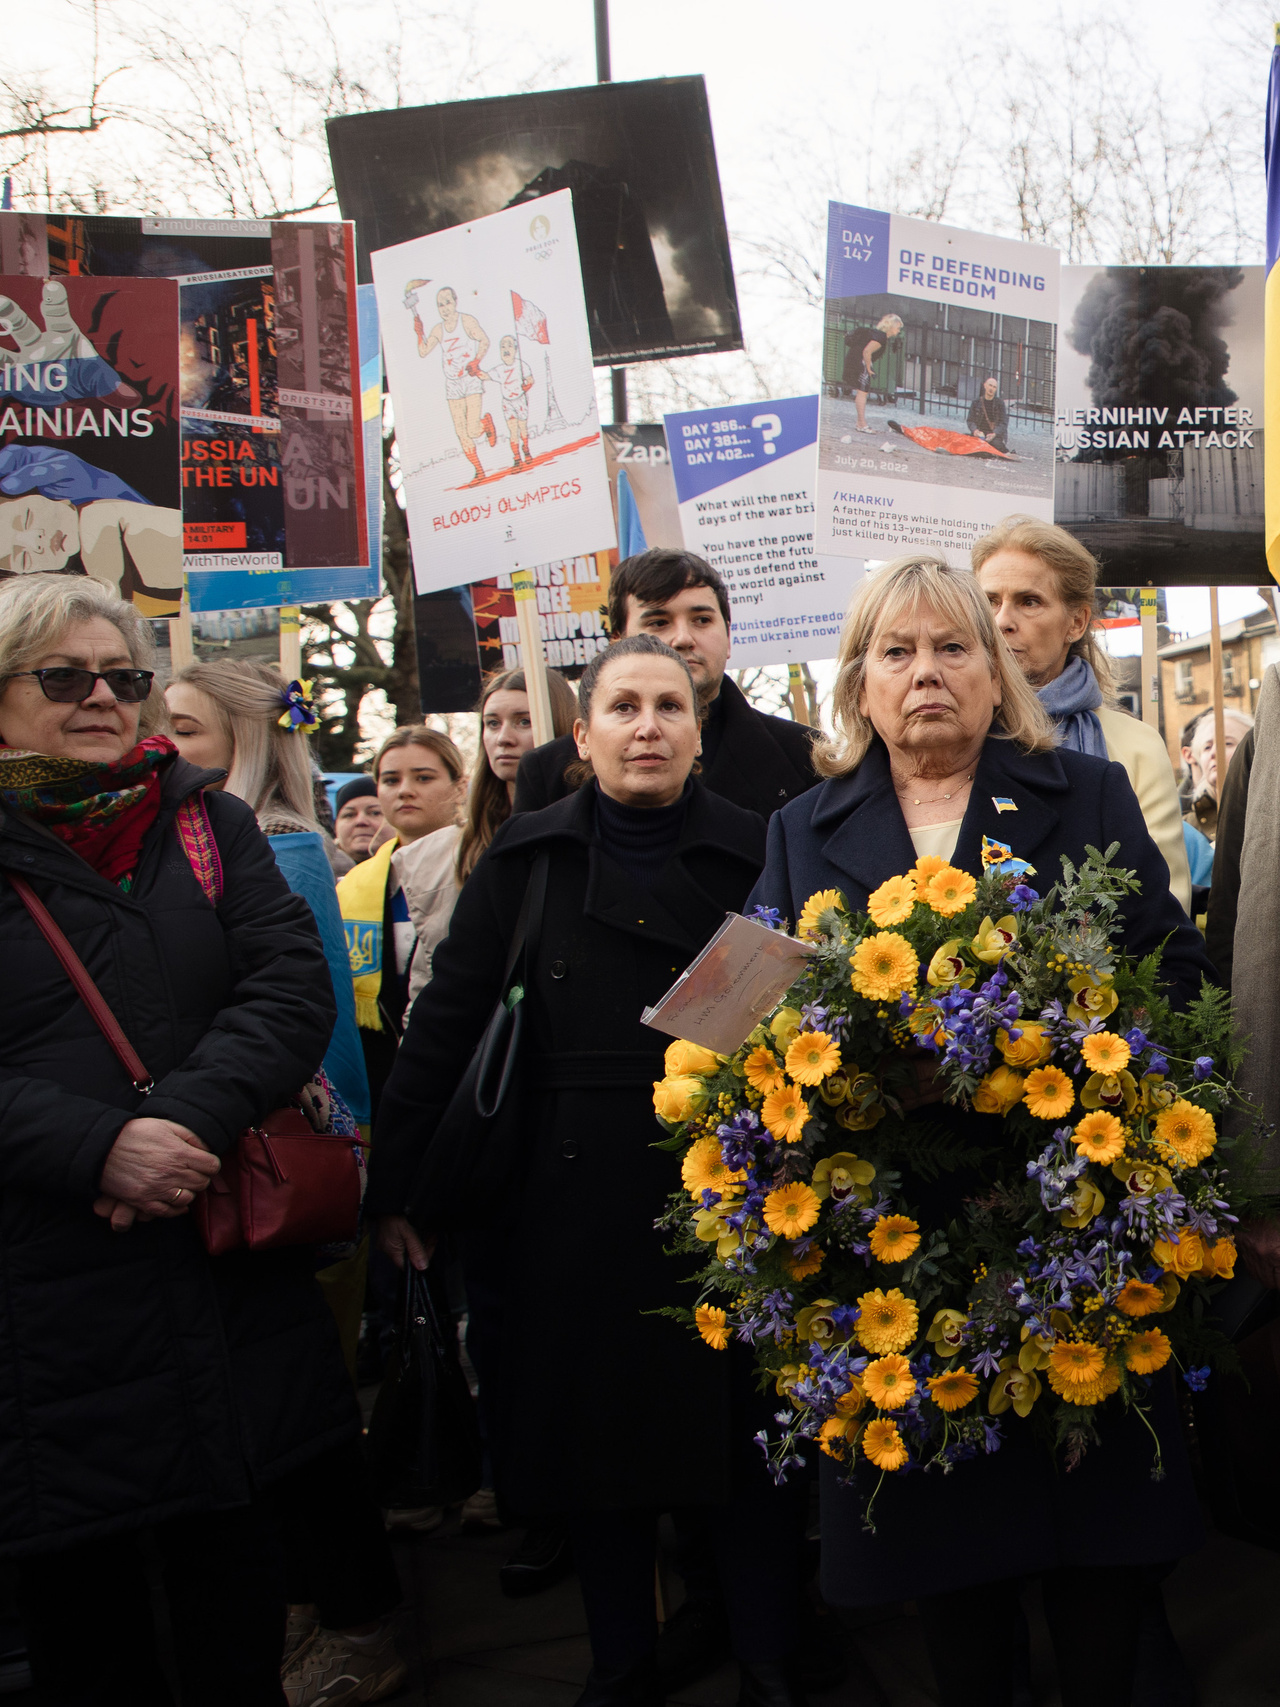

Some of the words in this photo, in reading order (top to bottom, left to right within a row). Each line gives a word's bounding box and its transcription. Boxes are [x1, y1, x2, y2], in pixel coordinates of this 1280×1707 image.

[842, 230, 875, 247] DAY
[843, 247, 873, 262] 147
[900, 249, 925, 267] OF
[932, 256, 1045, 291] DEFENDING
[899, 268, 996, 300] FREEDOM
[0, 363, 68, 392] ING
[0, 407, 154, 438] AINIANS
[1177, 407, 1254, 426] AFTER
[682, 423, 709, 437] DAY
[751, 413, 783, 455] ?
[1157, 430, 1255, 449] ATTACK
[684, 436, 711, 451] DAY
[687, 452, 714, 466] DAY
[834, 455, 858, 468] July
[860, 459, 878, 470] 20,
[879, 461, 909, 473] 2022
[182, 467, 233, 487] THE
[239, 466, 279, 487] UN
[286, 476, 349, 510] UN
[696, 500, 728, 512] What
[731, 496, 755, 508] will
[757, 494, 778, 505] the
[780, 491, 808, 502] next
[833, 491, 895, 507] /KHARKIV
[432, 503, 491, 532] BLOODY
[498, 478, 582, 514] OLYMPICS
[698, 514, 727, 526] days
[729, 510, 742, 522] of
[745, 508, 765, 520] the
[768, 507, 793, 518] war
[795, 502, 815, 514] bri
[832, 516, 858, 527] hand
[860, 518, 872, 528] of
[873, 520, 890, 530] his
[892, 523, 955, 539] 13-year-old
[956, 530, 976, 541] son,
[833, 505, 841, 513] A
[842, 506, 877, 518] father
[879, 510, 909, 523] prays
[911, 513, 939, 525] while
[941, 517, 978, 532] holding
[189, 526, 235, 534] MILITARY
[832, 526, 853, 537] just
[855, 528, 885, 541] killed
[887, 531, 899, 544] by
[901, 535, 942, 548] Russian
[944, 539, 974, 550] shelli
[703, 542, 725, 553] You
[727, 538, 756, 550] have
[758, 535, 778, 547] the
[781, 531, 813, 546] powe
[183, 553, 280, 567] WithTheWorld
[705, 552, 764, 566] influence
[766, 548, 786, 559] the
[737, 566, 751, 576] us
[753, 562, 796, 575] defend
[798, 558, 819, 570] the
[497, 556, 600, 589] AVSTAL
[739, 577, 775, 591] world
[778, 572, 826, 588] against
[536, 586, 572, 614] REE
[728, 593, 764, 605] anny!
[499, 610, 606, 644] MRIUPOL
[731, 611, 848, 632] #UnitedForFreedo
[732, 634, 758, 645] Arm
[761, 627, 810, 643] Ukraine
[812, 625, 841, 637] now!
[502, 637, 610, 671] DNDERS
[667, 996, 696, 1021] From
[694, 1006, 715, 1025] HM
